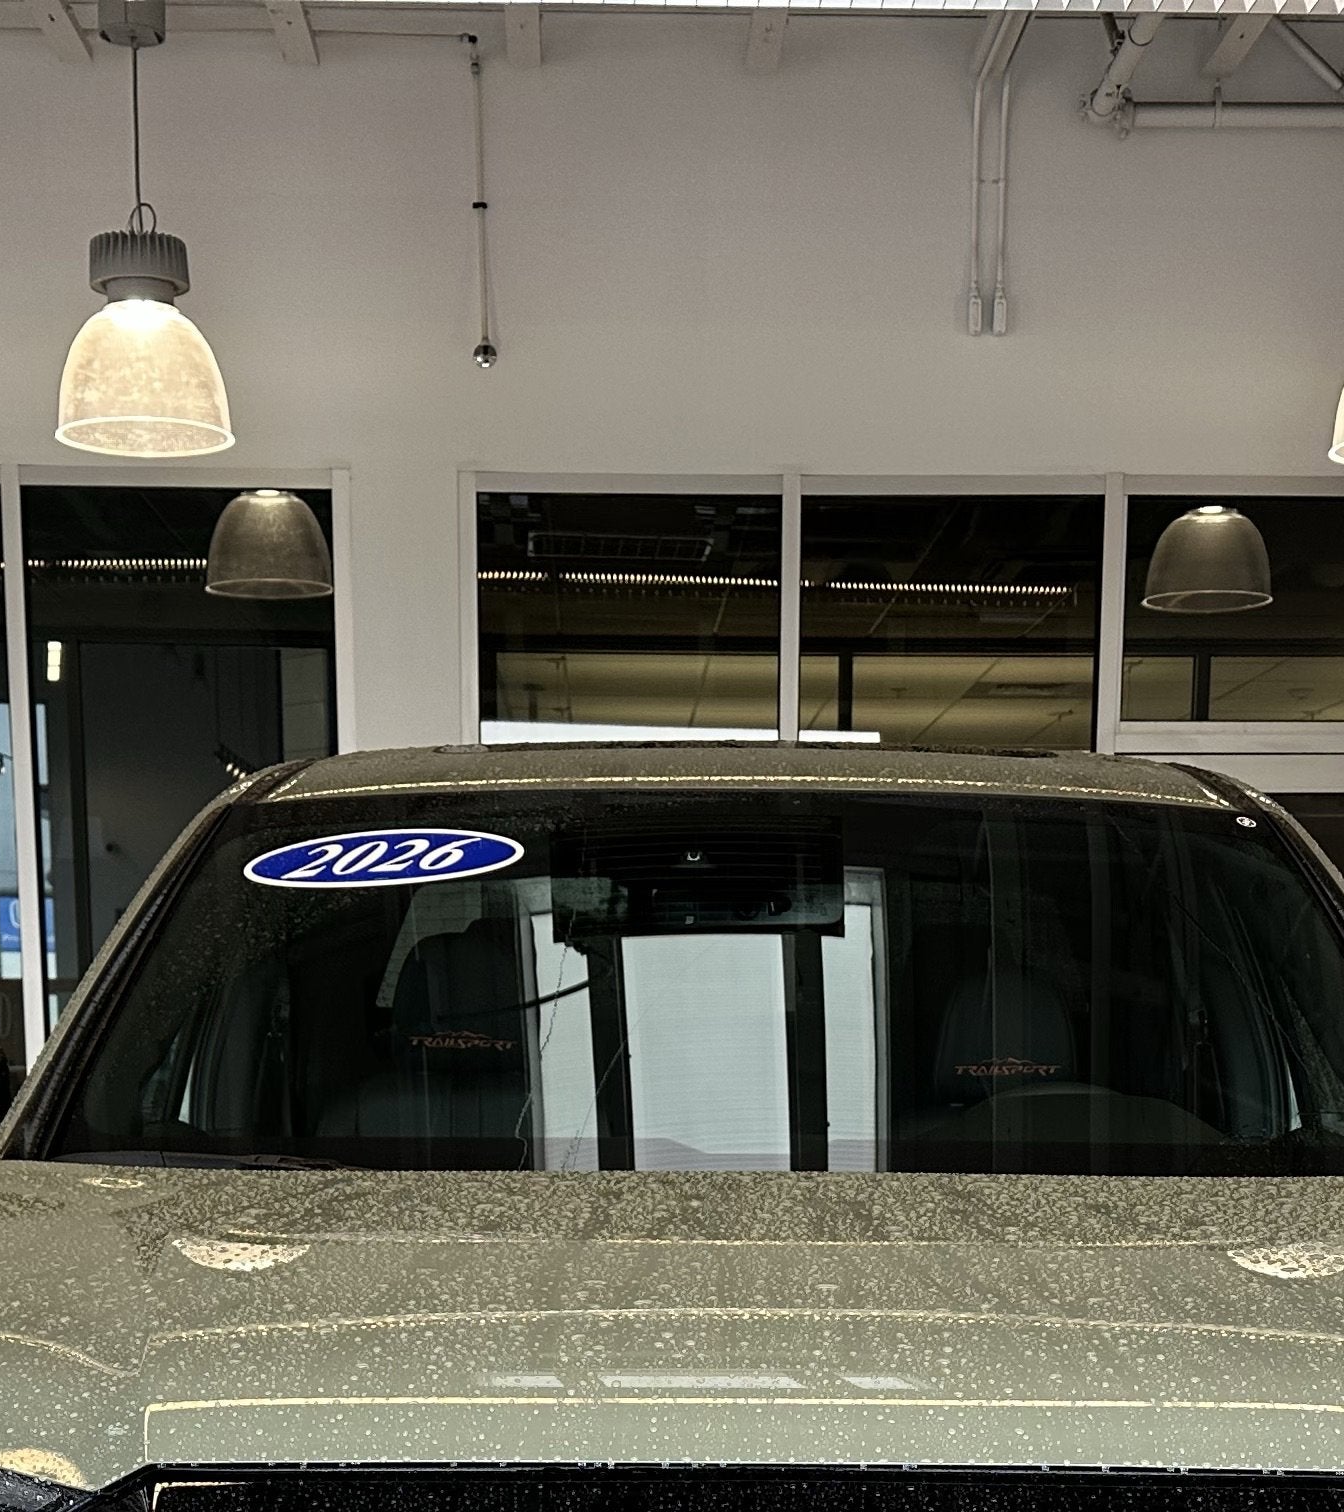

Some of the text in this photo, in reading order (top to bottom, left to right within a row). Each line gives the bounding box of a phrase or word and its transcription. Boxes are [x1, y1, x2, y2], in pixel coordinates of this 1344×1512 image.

[280, 838, 482, 880] 2026
[409, 1036, 517, 1050] TRAILSPORT
[954, 1065, 1061, 1076] TRAILSPORT
